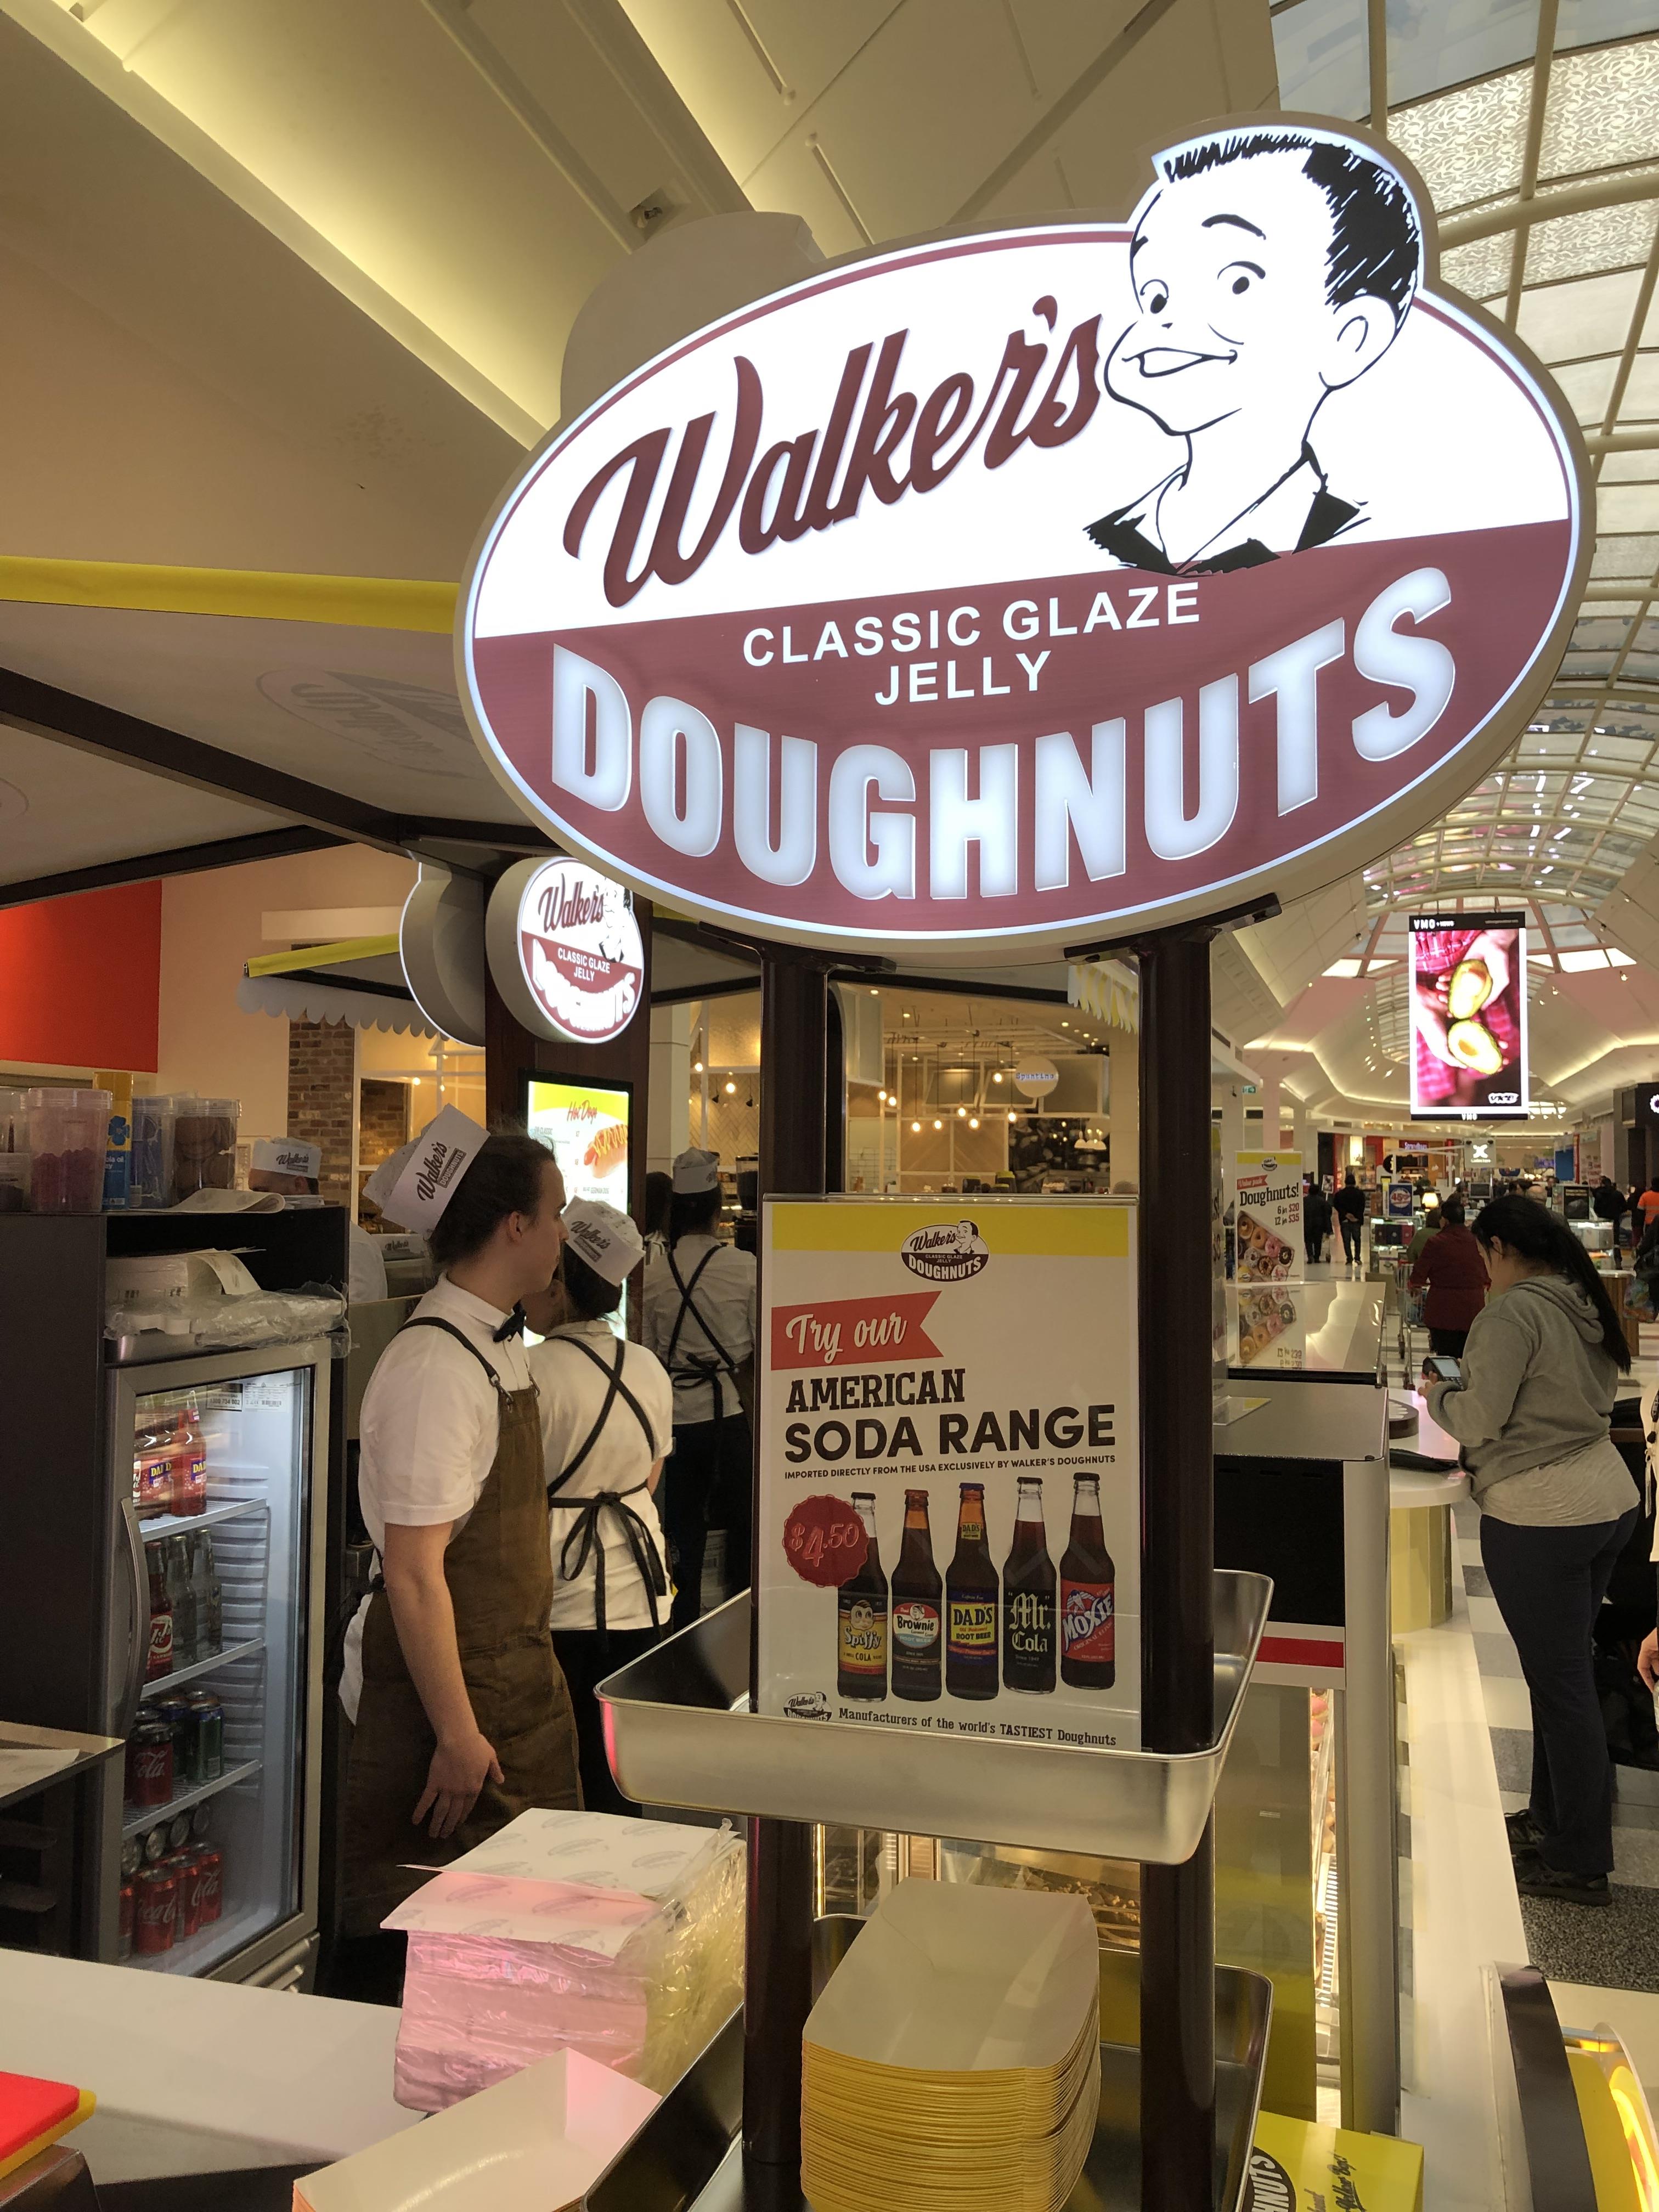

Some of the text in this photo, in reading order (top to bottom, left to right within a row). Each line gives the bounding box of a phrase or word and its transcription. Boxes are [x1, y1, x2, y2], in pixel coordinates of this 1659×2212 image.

[563, 296, 1102, 607] Walker's
[743, 583, 1201, 668] CLASSIC GLAZE
[875, 650, 1052, 706] JELLY
[552, 567, 1455, 901] DOUGHNUTS
[538, 873, 604, 933] Walker's
[1414, 919, 1435, 929] VMO
[557, 947, 611, 974] CLASSIC GLAZE
[574, 966, 595, 982] JELLY
[415, 1142, 448, 1201] Walker's
[439, 1150, 464, 1186] DOUGHNUTS
[1240, 1182, 1299, 1207] Doughnuts!
[1274, 1216, 1281, 1226] 12
[1288, 1213, 1300, 1224] $35
[1277, 1205, 1282, 1214] 6
[1289, 1203, 1299, 1212] $20
[571, 1221, 611, 1249] Walker's
[910, 1231, 956, 1252] Walker's
[909, 1254, 981, 1279] DOUGHNUTS
[786, 1312, 907, 1364] Try our
[786, 1368, 966, 1413] AMERICAN
[785, 1404, 1116, 1463] SODA RANGE
[785, 1455, 1116, 1479] IMPORTED DIRECTLY FROM THE USA EXCLUSIVELY BY WALKER'S DOUGHNUTS
[788, 1522, 860, 1567] $4.50
[896, 1615, 934, 1631] Brownie
[953, 1606, 993, 1626] DAD'S
[1062, 1593, 1113, 1652] MOXIE
[844, 1626, 882, 1650] Spiffy
[1012, 1631, 1048, 1652] Cola
[855, 1652, 872, 1662] COLA
[839, 1707, 1116, 1746] Manufacturers of the world's TASTIEST Doughnuts
